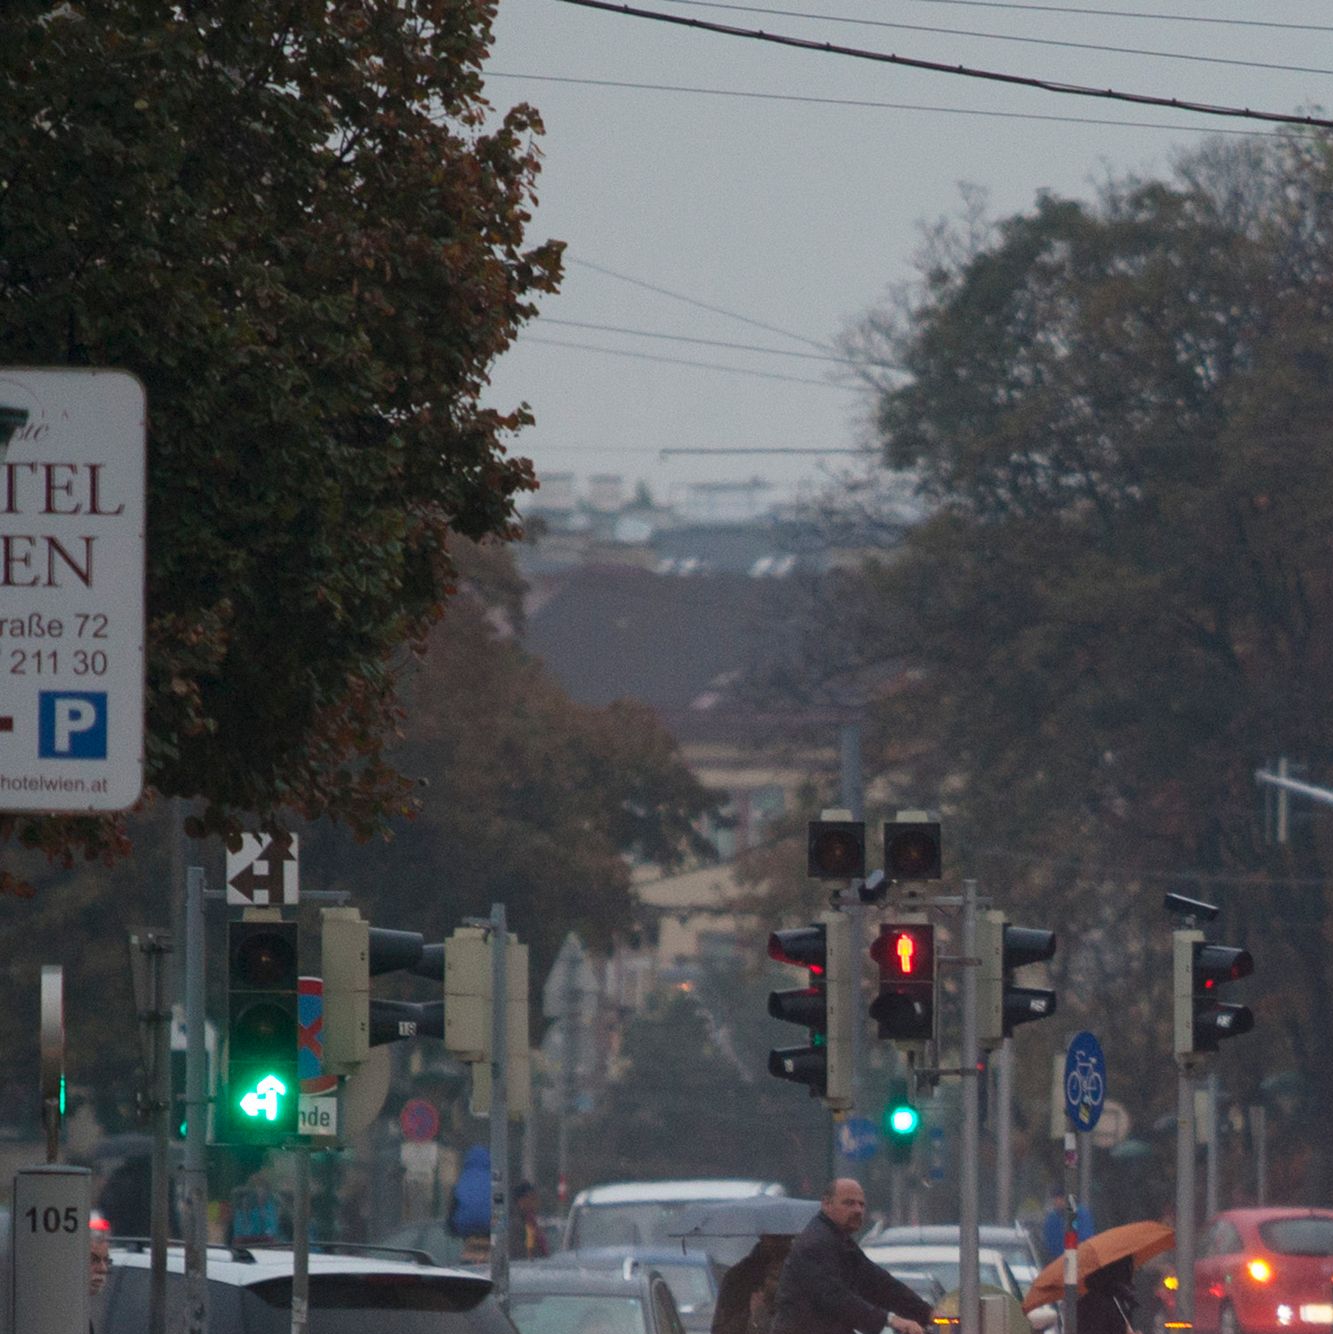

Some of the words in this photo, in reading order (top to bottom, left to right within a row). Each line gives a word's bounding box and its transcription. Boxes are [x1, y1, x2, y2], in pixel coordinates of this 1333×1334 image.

[75, 613, 108, 638] 72
[10, 650, 58, 675] 211
[73, 650, 107, 675] 30
[54, 699, 97, 753] P
[25, 1207, 78, 1233] 105
